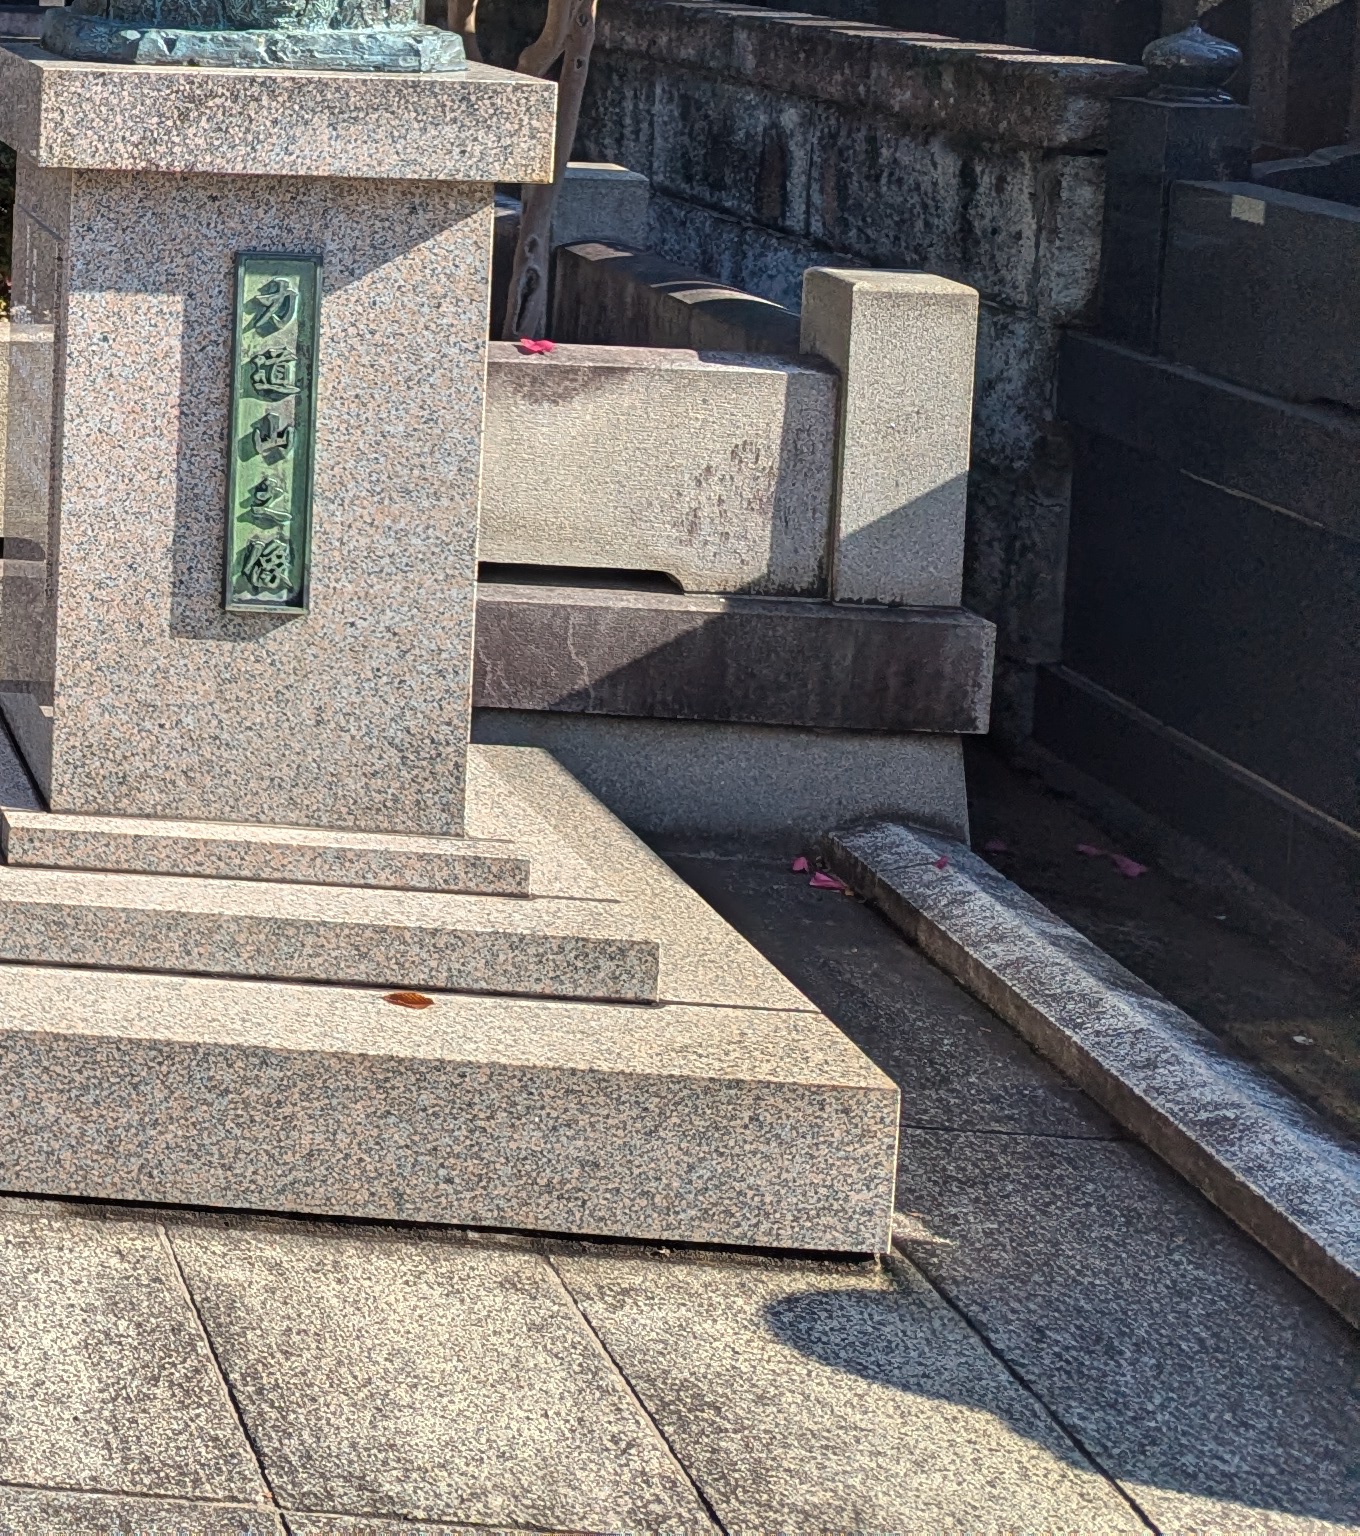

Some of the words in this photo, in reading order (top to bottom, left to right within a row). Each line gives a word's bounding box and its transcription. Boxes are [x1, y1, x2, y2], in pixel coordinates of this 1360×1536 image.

[241, 276, 301, 593] 力道山之像
